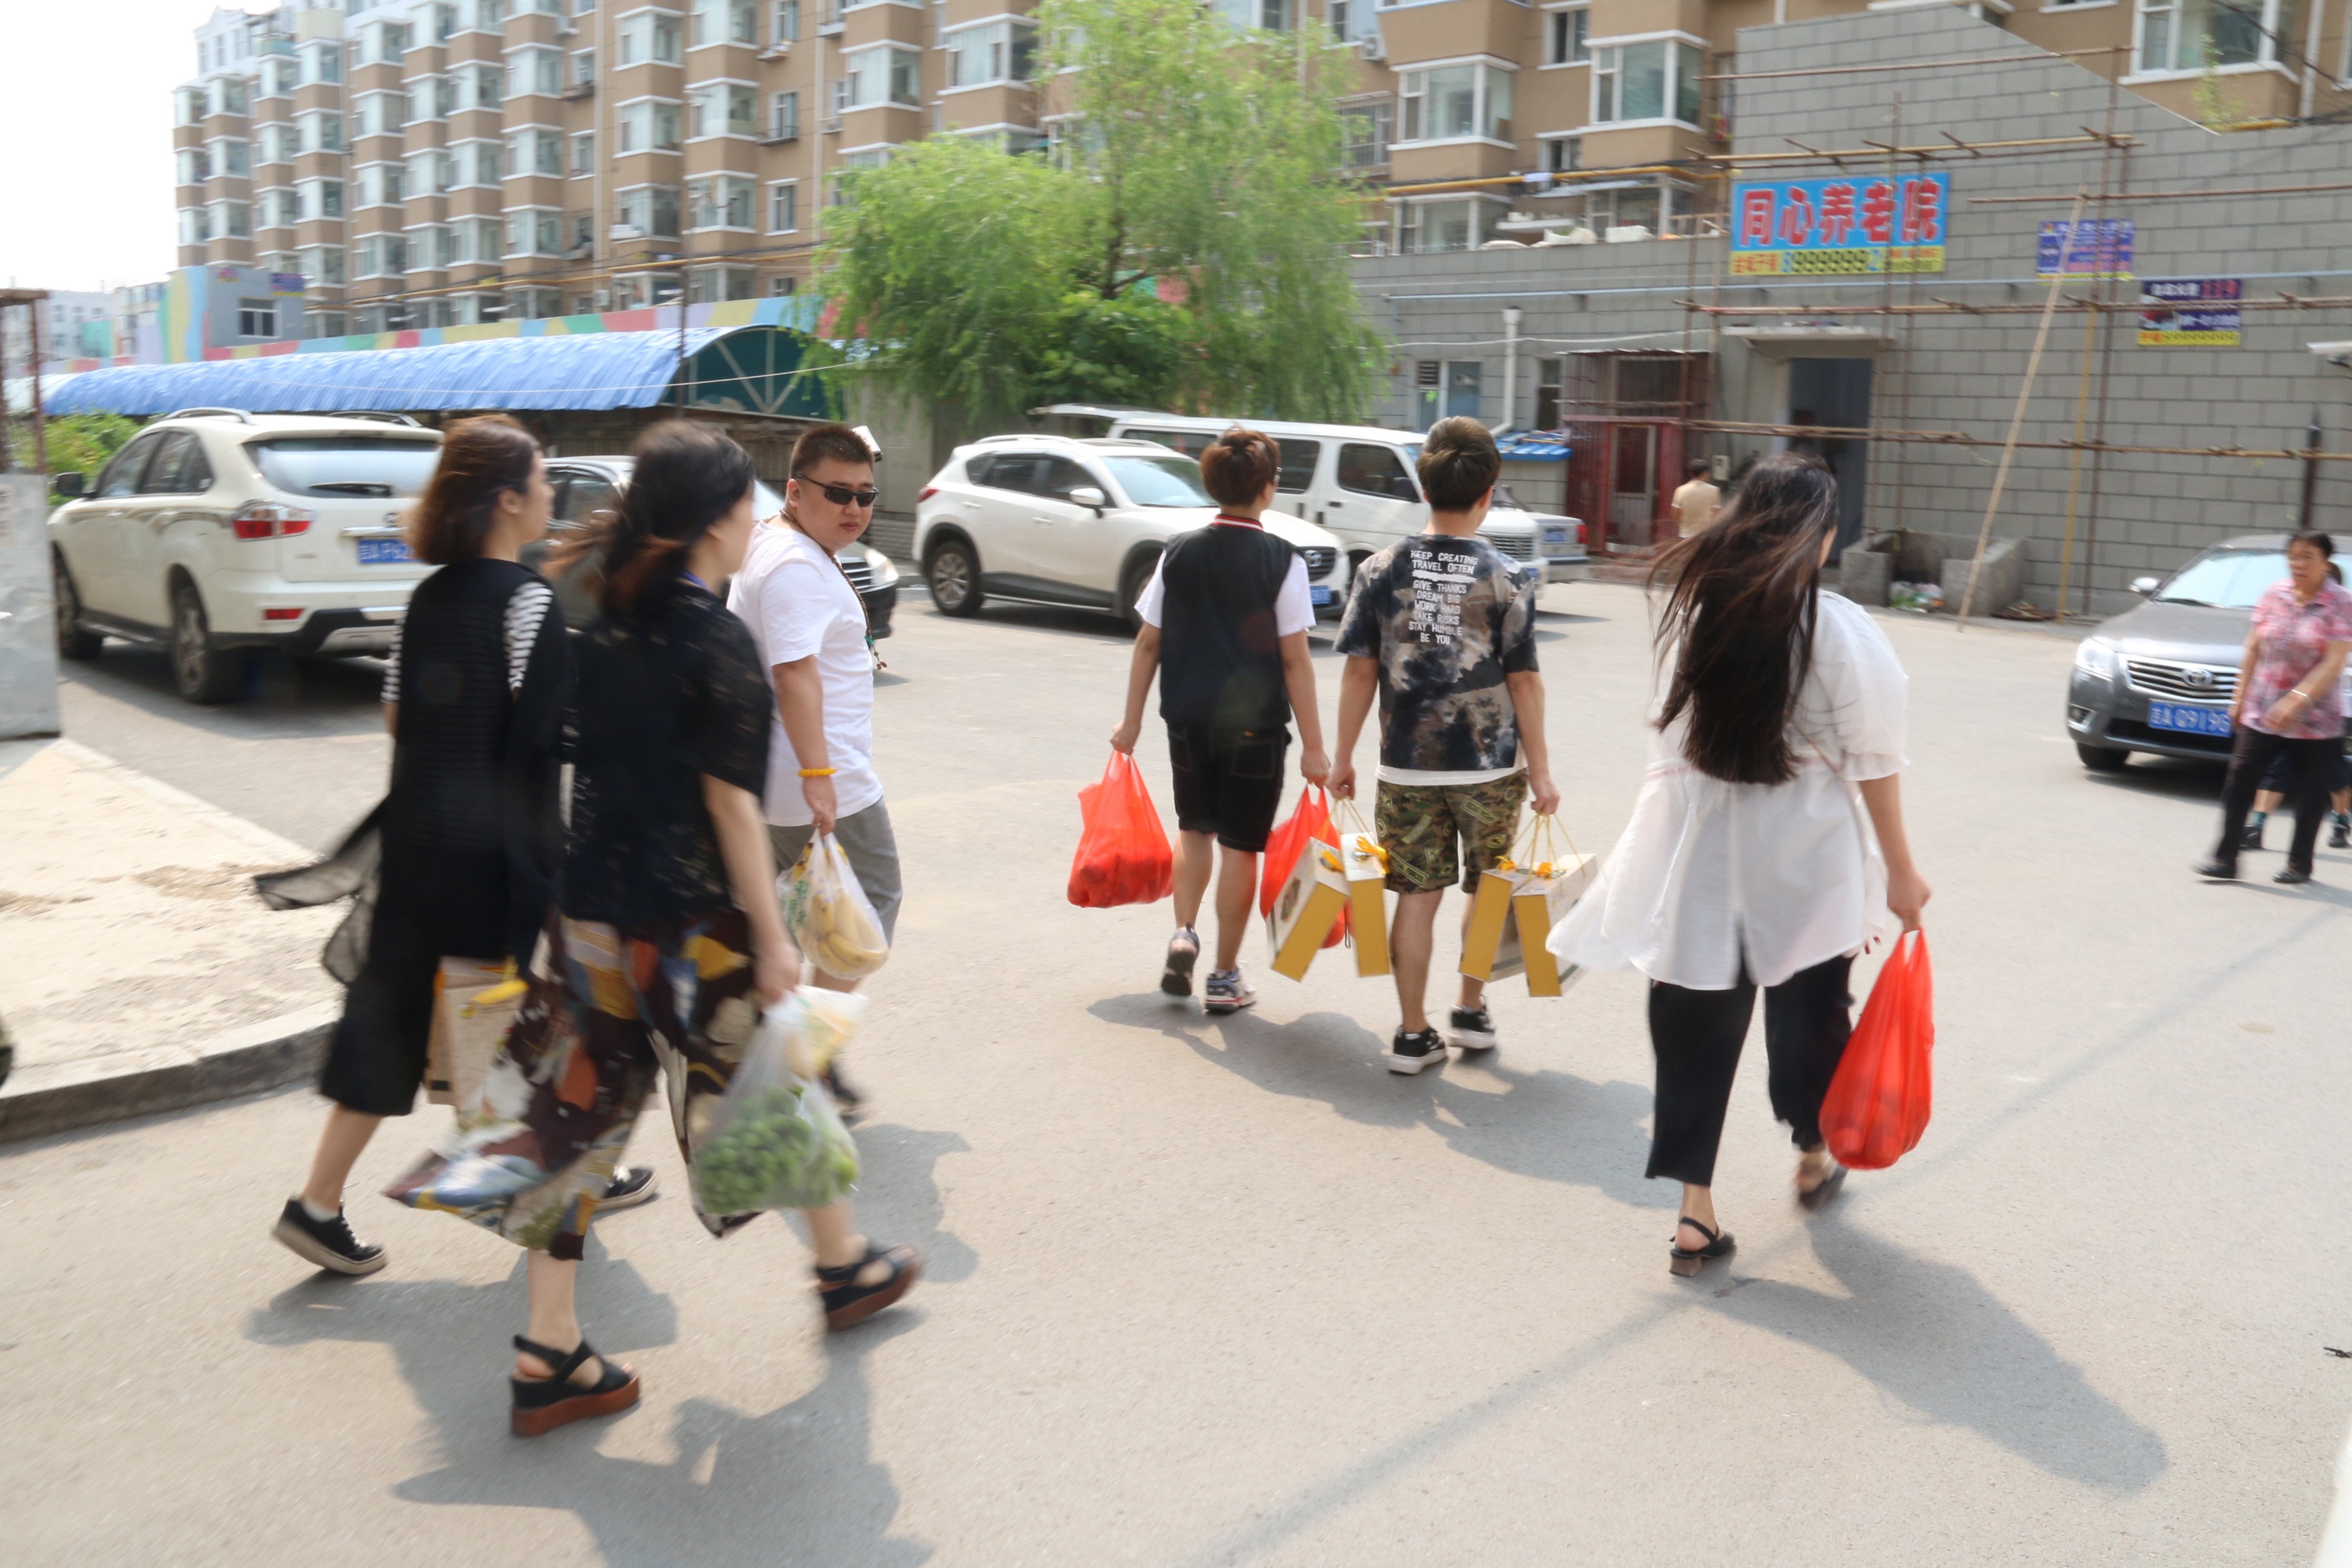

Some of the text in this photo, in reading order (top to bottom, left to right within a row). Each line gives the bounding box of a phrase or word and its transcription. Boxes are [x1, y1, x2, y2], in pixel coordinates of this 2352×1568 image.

[1740, 177, 1940, 247] 同心养老院
[1410, 550, 1479, 565] KEEP CREATING
[1412, 560, 1475, 574] TRAVEL OFTEN
[1413, 580, 1467, 594] GIVE THANKS
[1416, 590, 1460, 603] DREAM BIG
[1414, 600, 1461, 614] WORK HARD
[1413, 611, 1460, 625] TAKE RISKS
[1408, 622, 1463, 636] STAY HUMBLE
[1420, 632, 1451, 645] BE YOU
